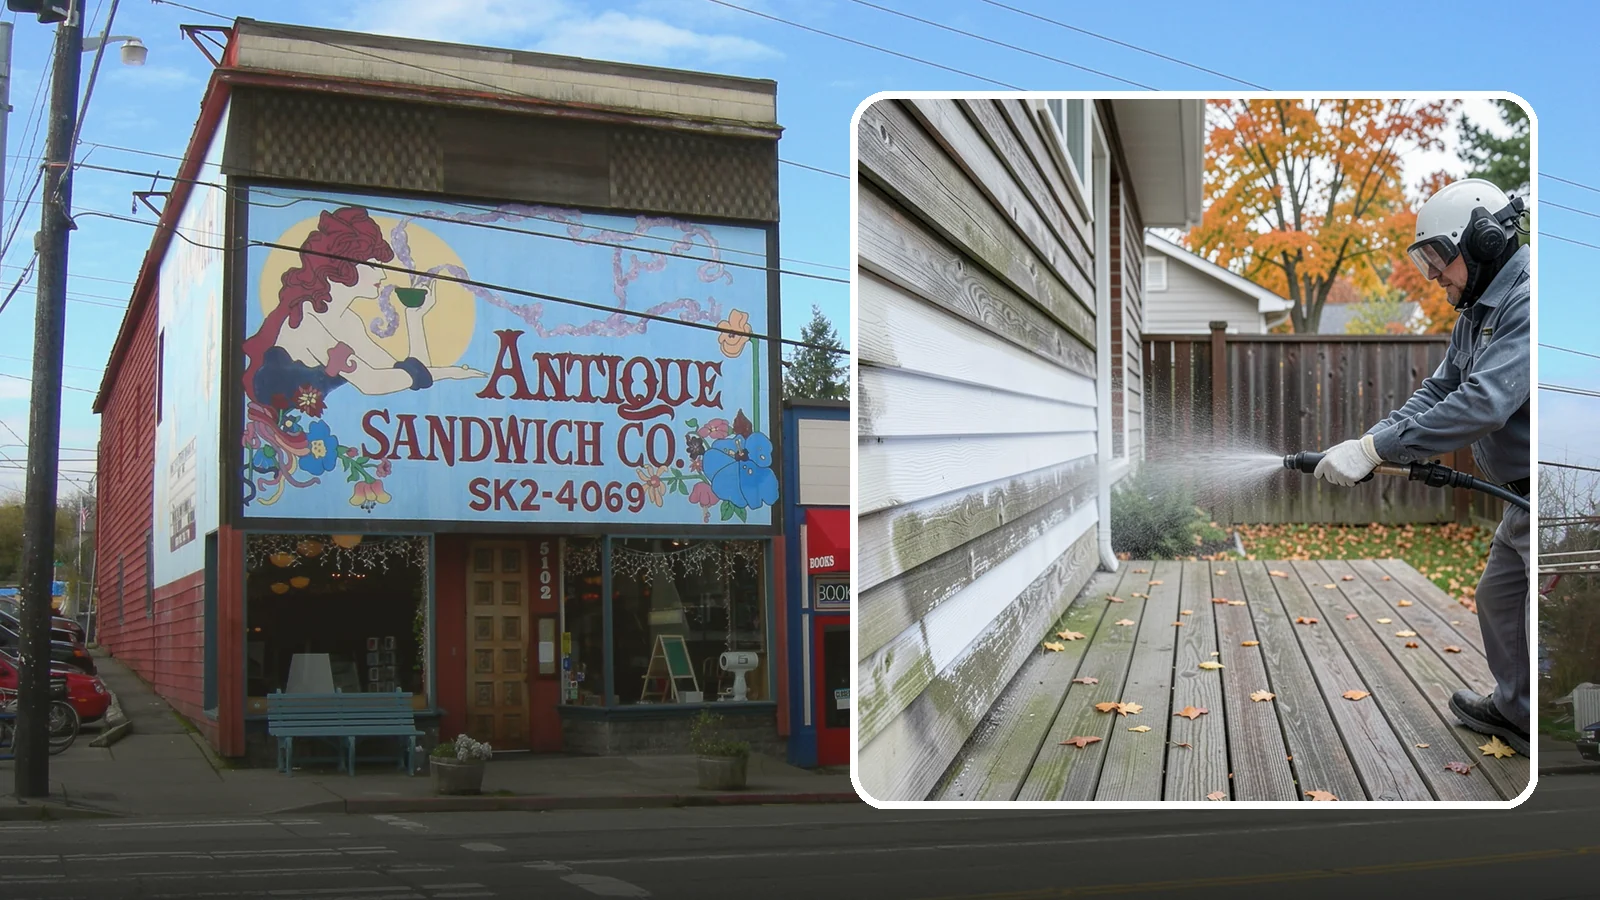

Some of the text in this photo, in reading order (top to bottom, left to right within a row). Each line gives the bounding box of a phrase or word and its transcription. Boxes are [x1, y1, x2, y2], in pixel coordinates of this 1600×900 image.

[361, 408, 685, 469] SANDWICH CO.
[468, 476, 646, 513] SK2-4069
[539, 541, 552, 600] 5102
[809, 555, 835, 569] BOOKS
